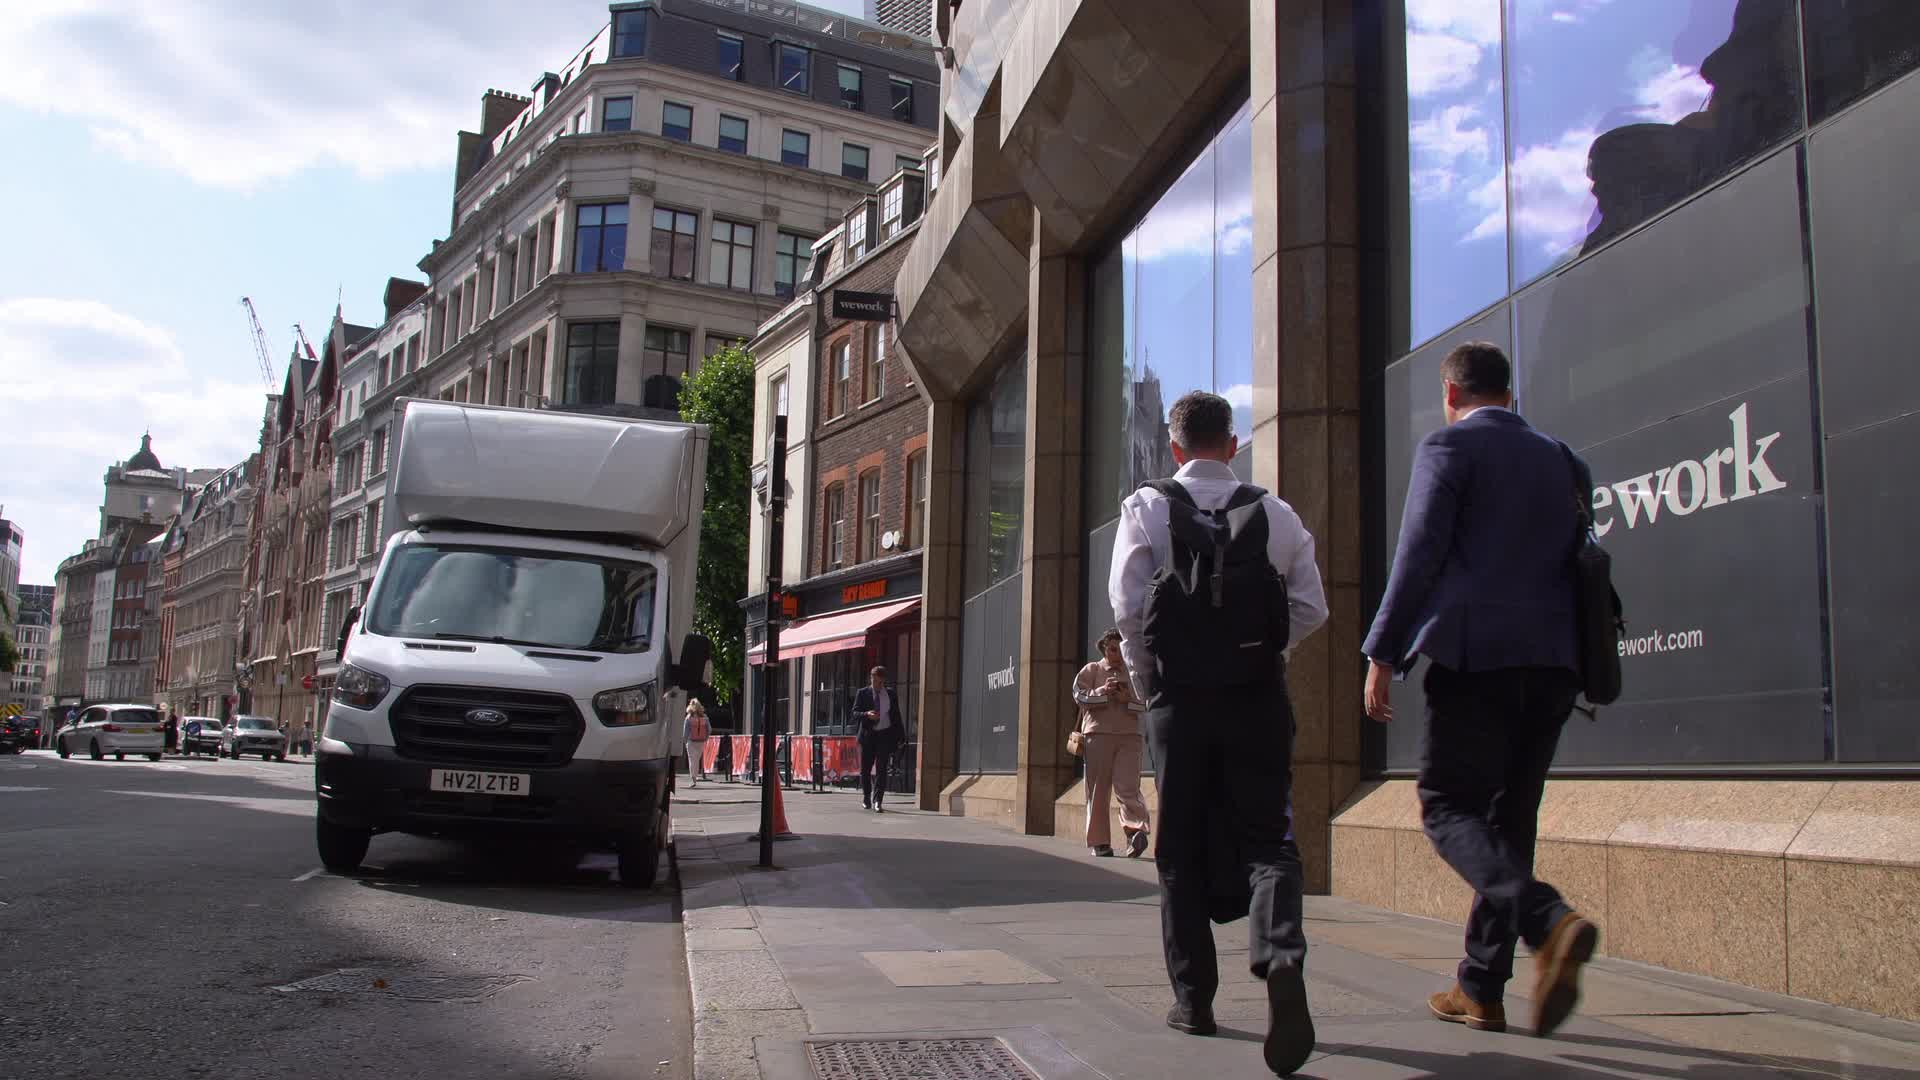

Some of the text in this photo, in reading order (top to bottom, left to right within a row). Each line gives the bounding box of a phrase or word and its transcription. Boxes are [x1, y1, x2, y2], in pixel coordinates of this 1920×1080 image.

[840, 301, 884, 311] wework
[1592, 402, 1786, 536] ework
[1617, 629, 1703, 656] ework.com
[987, 655, 1015, 691] wework
[443, 772, 520, 791] HV21 ZTB
